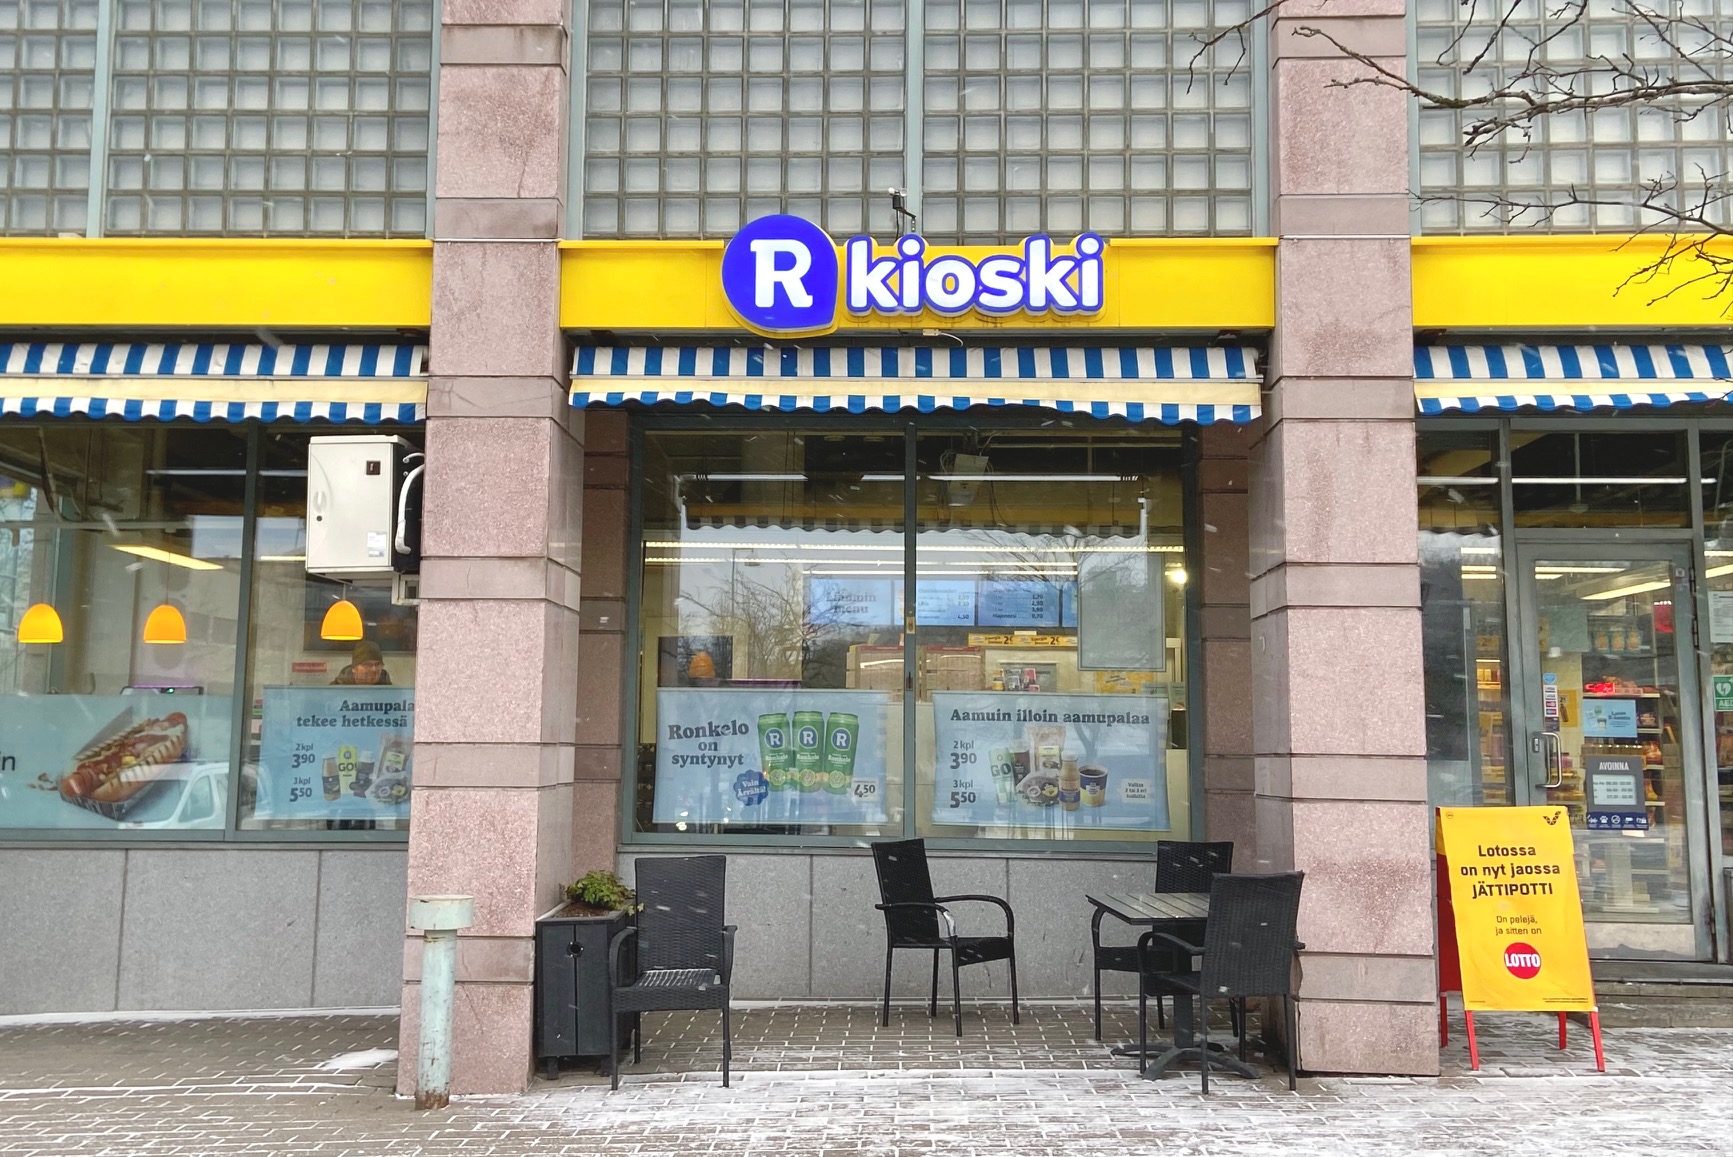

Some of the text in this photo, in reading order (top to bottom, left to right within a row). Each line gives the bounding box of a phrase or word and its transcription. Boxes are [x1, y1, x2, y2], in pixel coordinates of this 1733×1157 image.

[750, 234, 1102, 312] R kioski
[296, 714, 407, 727] tekee hetkessä
[950, 708, 1150, 727] Aamuin illoin aamupalaa
[668, 719, 749, 740] Ronkelo
[769, 732, 781, 746] R
[803, 731, 814, 744] R
[836, 732, 847, 746] R
[295, 743, 314, 752] 2 kpl
[698, 741, 718, 751] on
[953, 740, 974, 751] 2 kpl
[671, 753, 744, 769] syntynyt
[1599, 761, 1630, 771] AVOINNA
[298, 777, 311, 786] kpl
[742, 779, 759, 787] Vain
[952, 779, 974, 790] 3 kpl
[1478, 845, 1536, 857] Lotossa
[1461, 862, 1560, 880] on nyt jaossa
[1472, 881, 1553, 899] JÄTTIPOTTI
[1496, 916, 1508, 924] On
[1495, 927, 1504, 936] ja
[1506, 926, 1529, 935] sitten
[1504, 953, 1541, 968] LOTTO
